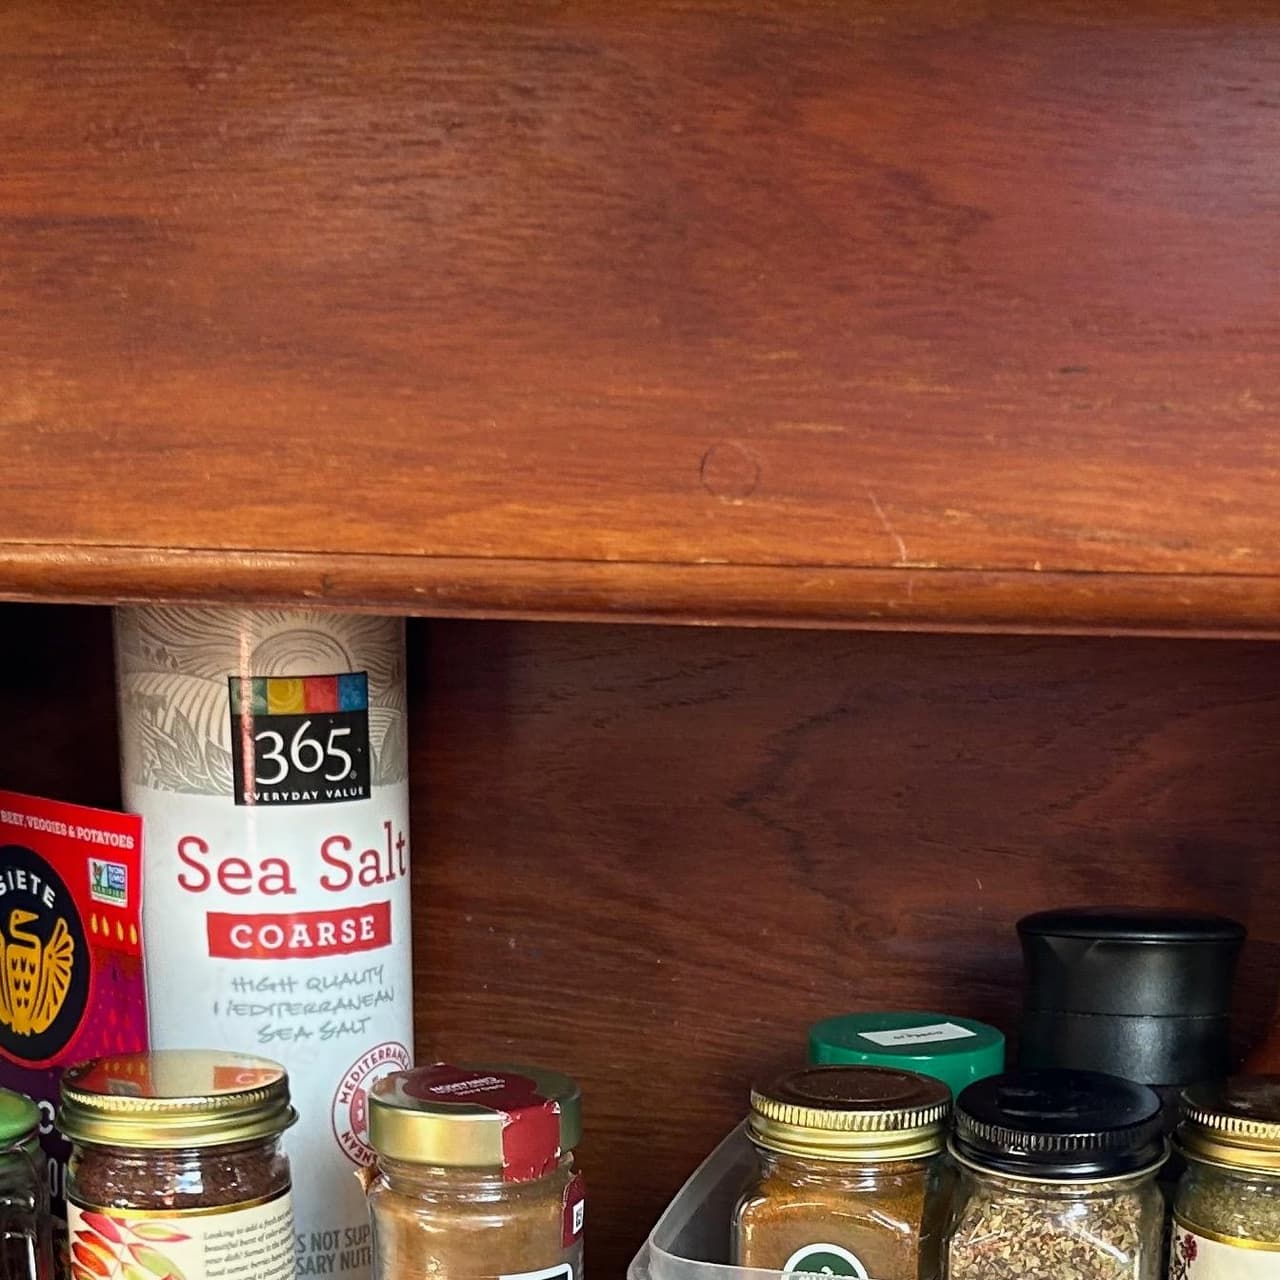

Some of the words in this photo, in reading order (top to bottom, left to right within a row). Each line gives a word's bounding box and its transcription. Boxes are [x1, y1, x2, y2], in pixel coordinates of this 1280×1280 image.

[255, 720, 353, 785] 365
[244, 790, 319, 802] EVERYDAY
[326, 786, 364, 799] VALUE
[76, 826, 135, 850] POTATOES
[178, 836, 297, 895] Sea
[320, 820, 407, 892] Salt
[229, 916, 376, 949] COARSE
[231, 976, 299, 993] HIGH
[306, 965, 384, 992] QUALITY
[258, 1024, 314, 1043] SEA
[320, 1017, 372, 1041] SALT
[311, 1230, 341, 1252] NOT
